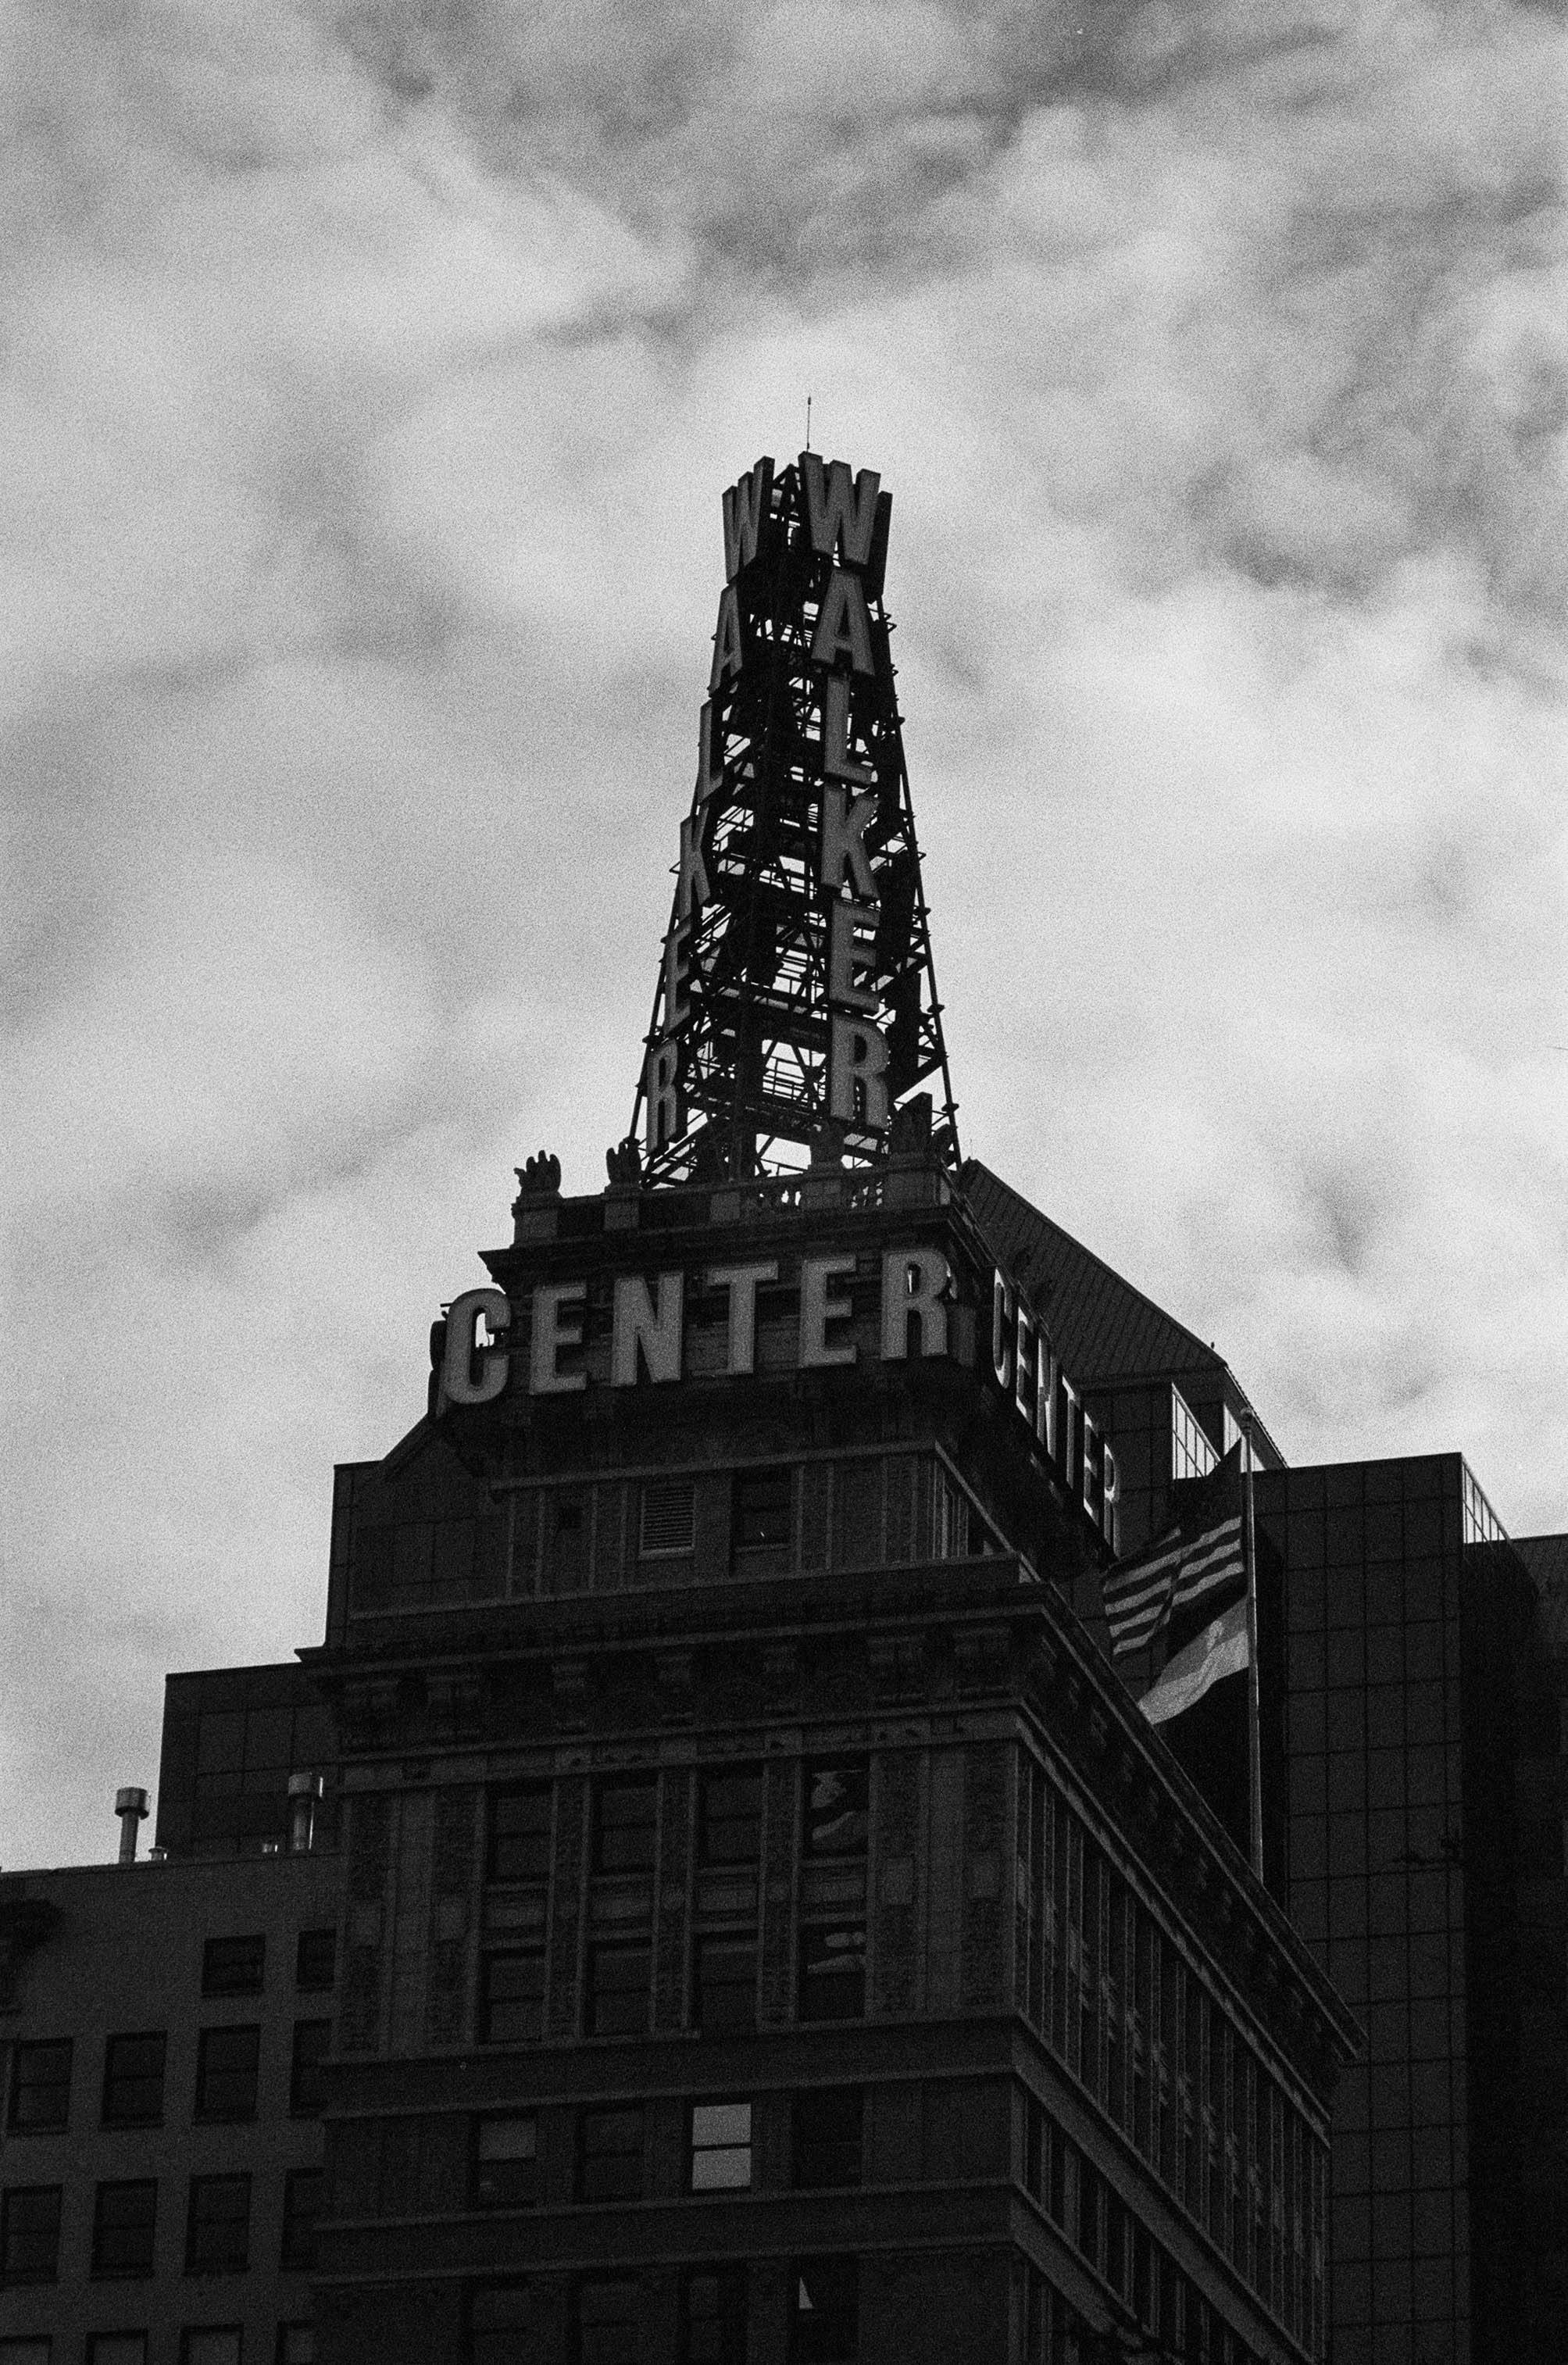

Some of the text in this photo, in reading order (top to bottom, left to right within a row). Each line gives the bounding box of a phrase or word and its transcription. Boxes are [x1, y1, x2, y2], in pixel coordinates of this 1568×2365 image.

[645, 456, 772, 1154] WALKER
[800, 452, 891, 1130] WALKER
[441, 1249, 948, 1404] CENTER
[991, 1266, 1121, 1558] CENTER
